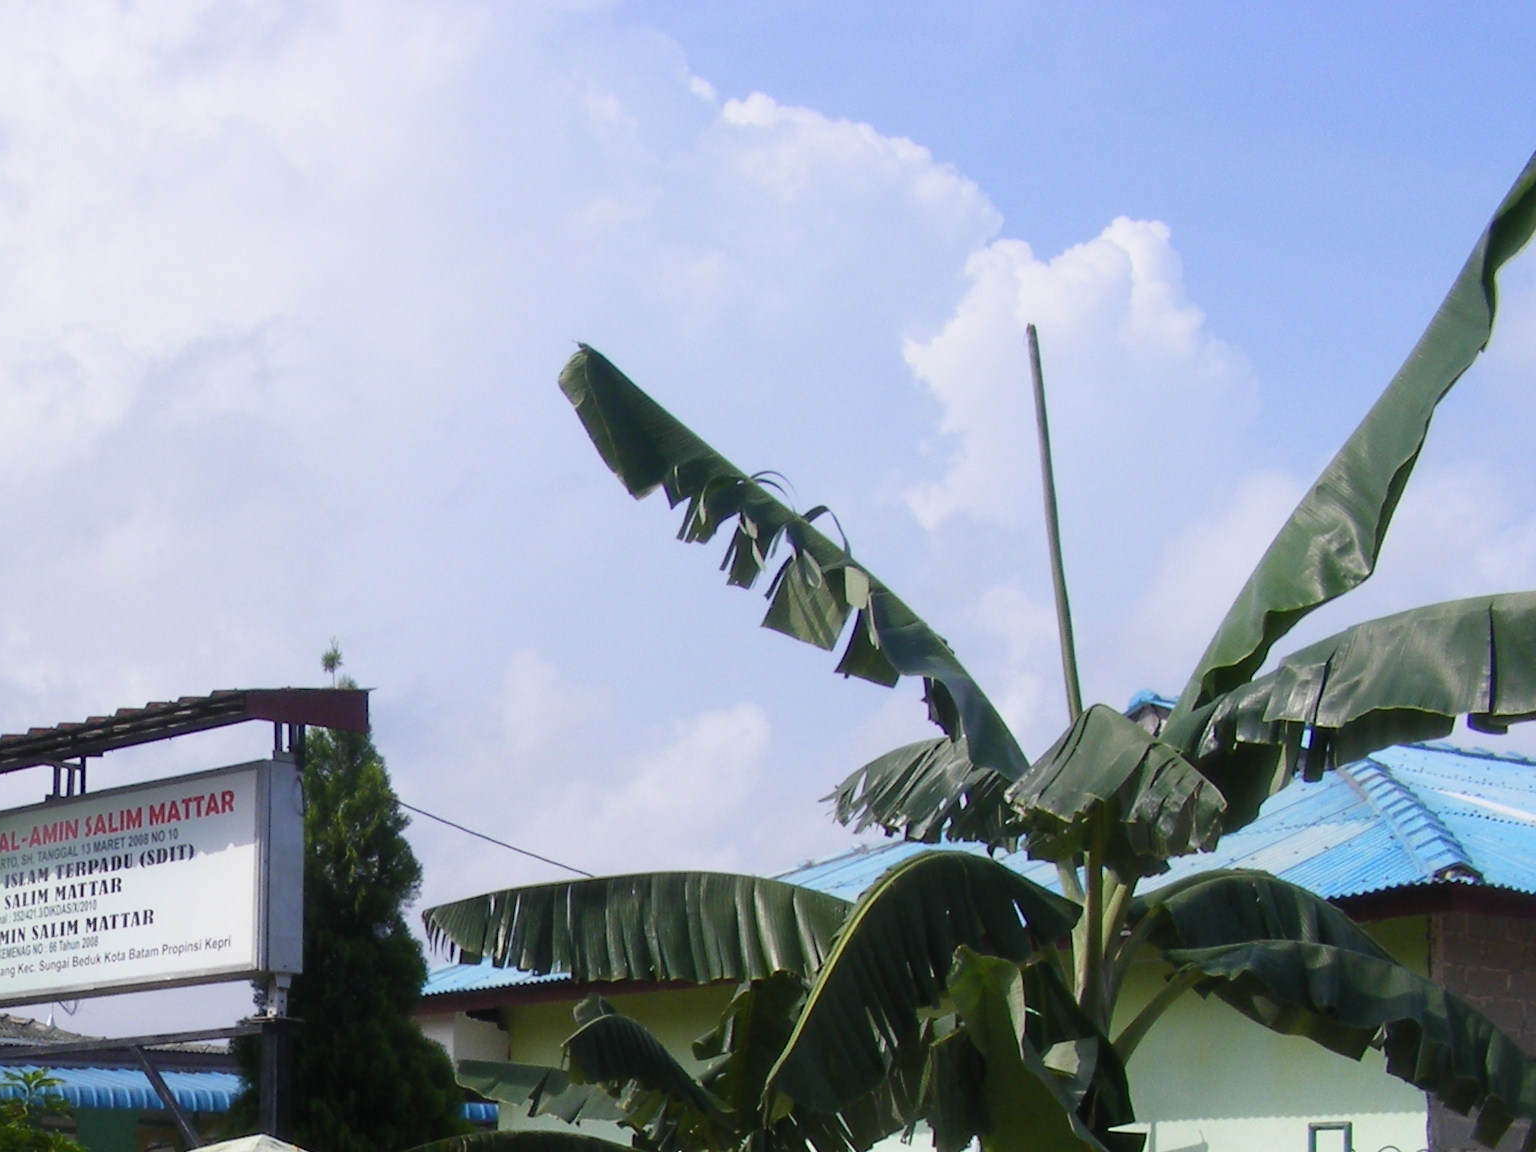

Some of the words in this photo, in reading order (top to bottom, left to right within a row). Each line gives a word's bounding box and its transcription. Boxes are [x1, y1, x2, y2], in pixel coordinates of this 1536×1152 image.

[84, 806, 143, 837] SALIM
[149, 790, 235, 826] MATTAR
[38, 843, 78, 862] TANGGAL
[81, 842, 91, 855] 13
[93, 836, 126, 852] MARET
[128, 832, 149, 847] 2008
[151, 829, 165, 843] NO
[169, 827, 179, 841] 10
[4, 866, 50, 889] ISLAM
[56, 851, 133, 881] TERPADU
[139, 843, 195, 869] (SDIT)
[4, 888, 50, 911] SALIM
[55, 877, 122, 901] MATTAR
[32, 919, 79, 941] SALIM
[86, 909, 154, 934] MATTAR
[33, 942, 44, 956] NO
[59, 939, 80, 952] Tahun
[82, 935, 99, 949] 2008
[39, 954, 69, 973] Sungai
[72, 951, 102, 968] Beduk
[104, 947, 126, 963] Kota
[129, 944, 159, 961] Batam
[162, 938, 202, 958] Propinsi
[204, 935, 232, 952] Kepri
